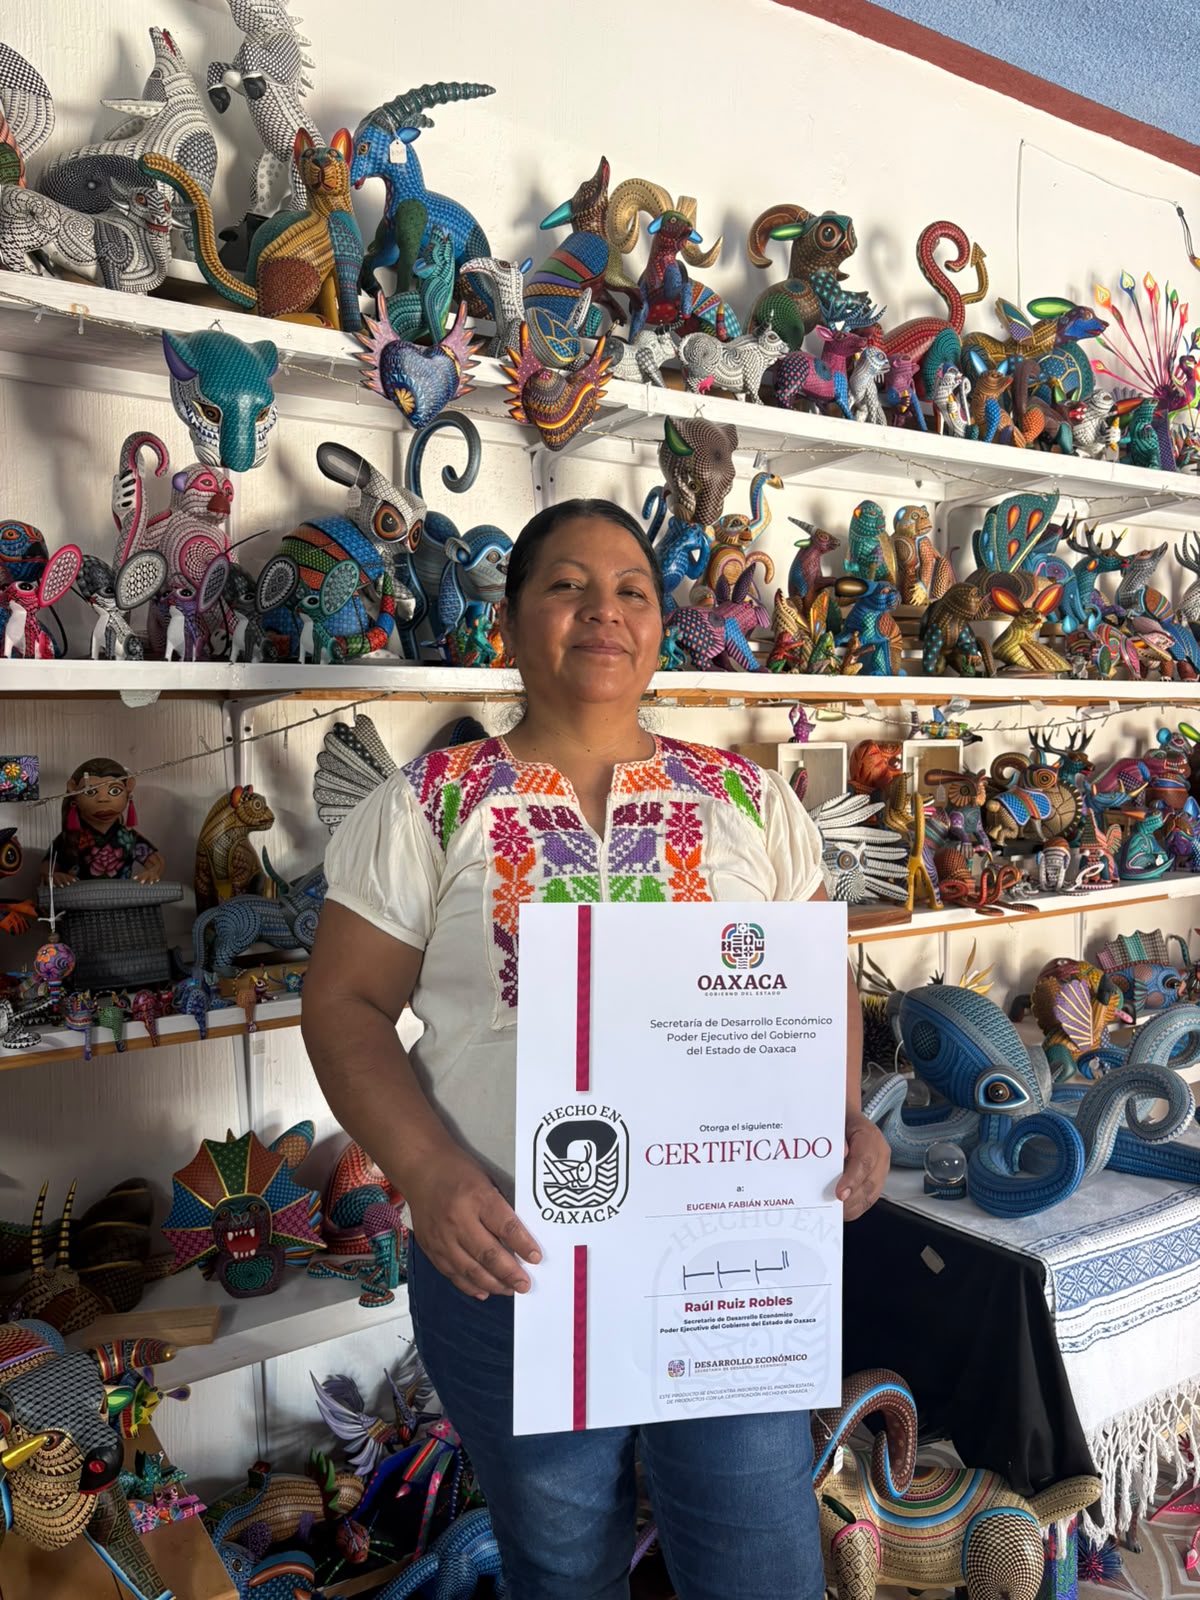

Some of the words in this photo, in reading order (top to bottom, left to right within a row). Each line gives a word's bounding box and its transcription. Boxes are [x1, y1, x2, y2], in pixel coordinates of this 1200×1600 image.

[697, 974, 787, 990] OAXACA
[650, 1017, 703, 1028] Secretaría
[705, 1018, 718, 1028] de
[721, 1017, 773, 1026] Desarrollo
[775, 1014, 832, 1026] Económico
[667, 1032, 698, 1042] Poder
[701, 1031, 748, 1043] Ejecutivo
[751, 1030, 767, 1040] del
[769, 1030, 816, 1040] Gobierno
[686, 1046, 703, 1055] del
[706, 1045, 741, 1055] Estado
[743, 1045, 757, 1054] de
[759, 1044, 796, 1053] Oaxaca
[541, 1104, 597, 1126] HECHO
[600, 1106, 622, 1121] EN
[699, 1123, 730, 1132] Otorga
[732, 1122, 739, 1131] el
[742, 1121, 783, 1132] siguiente:
[645, 1137, 832, 1166] CERTIFICADO
[686, 1202, 726, 1211] EUGENIA
[728, 1199, 761, 1208] FABIÁN
[763, 1198, 794, 1206] XUANA
[541, 1206, 620, 1224] OAXACA
[684, 1301, 713, 1312] Raúl
[717, 1300, 745, 1310] Ruiz
[749, 1296, 793, 1308] Robles
[684, 1317, 717, 1325] Secretario
[726, 1313, 758, 1321] Desarrollo
[680, 1325, 709, 1333] Ejecutivo
[722, 1321, 750, 1329] Gobierno
[694, 1358, 754, 1368] DESARROLLO
[755, 1353, 807, 1364] ECONÓMICO
